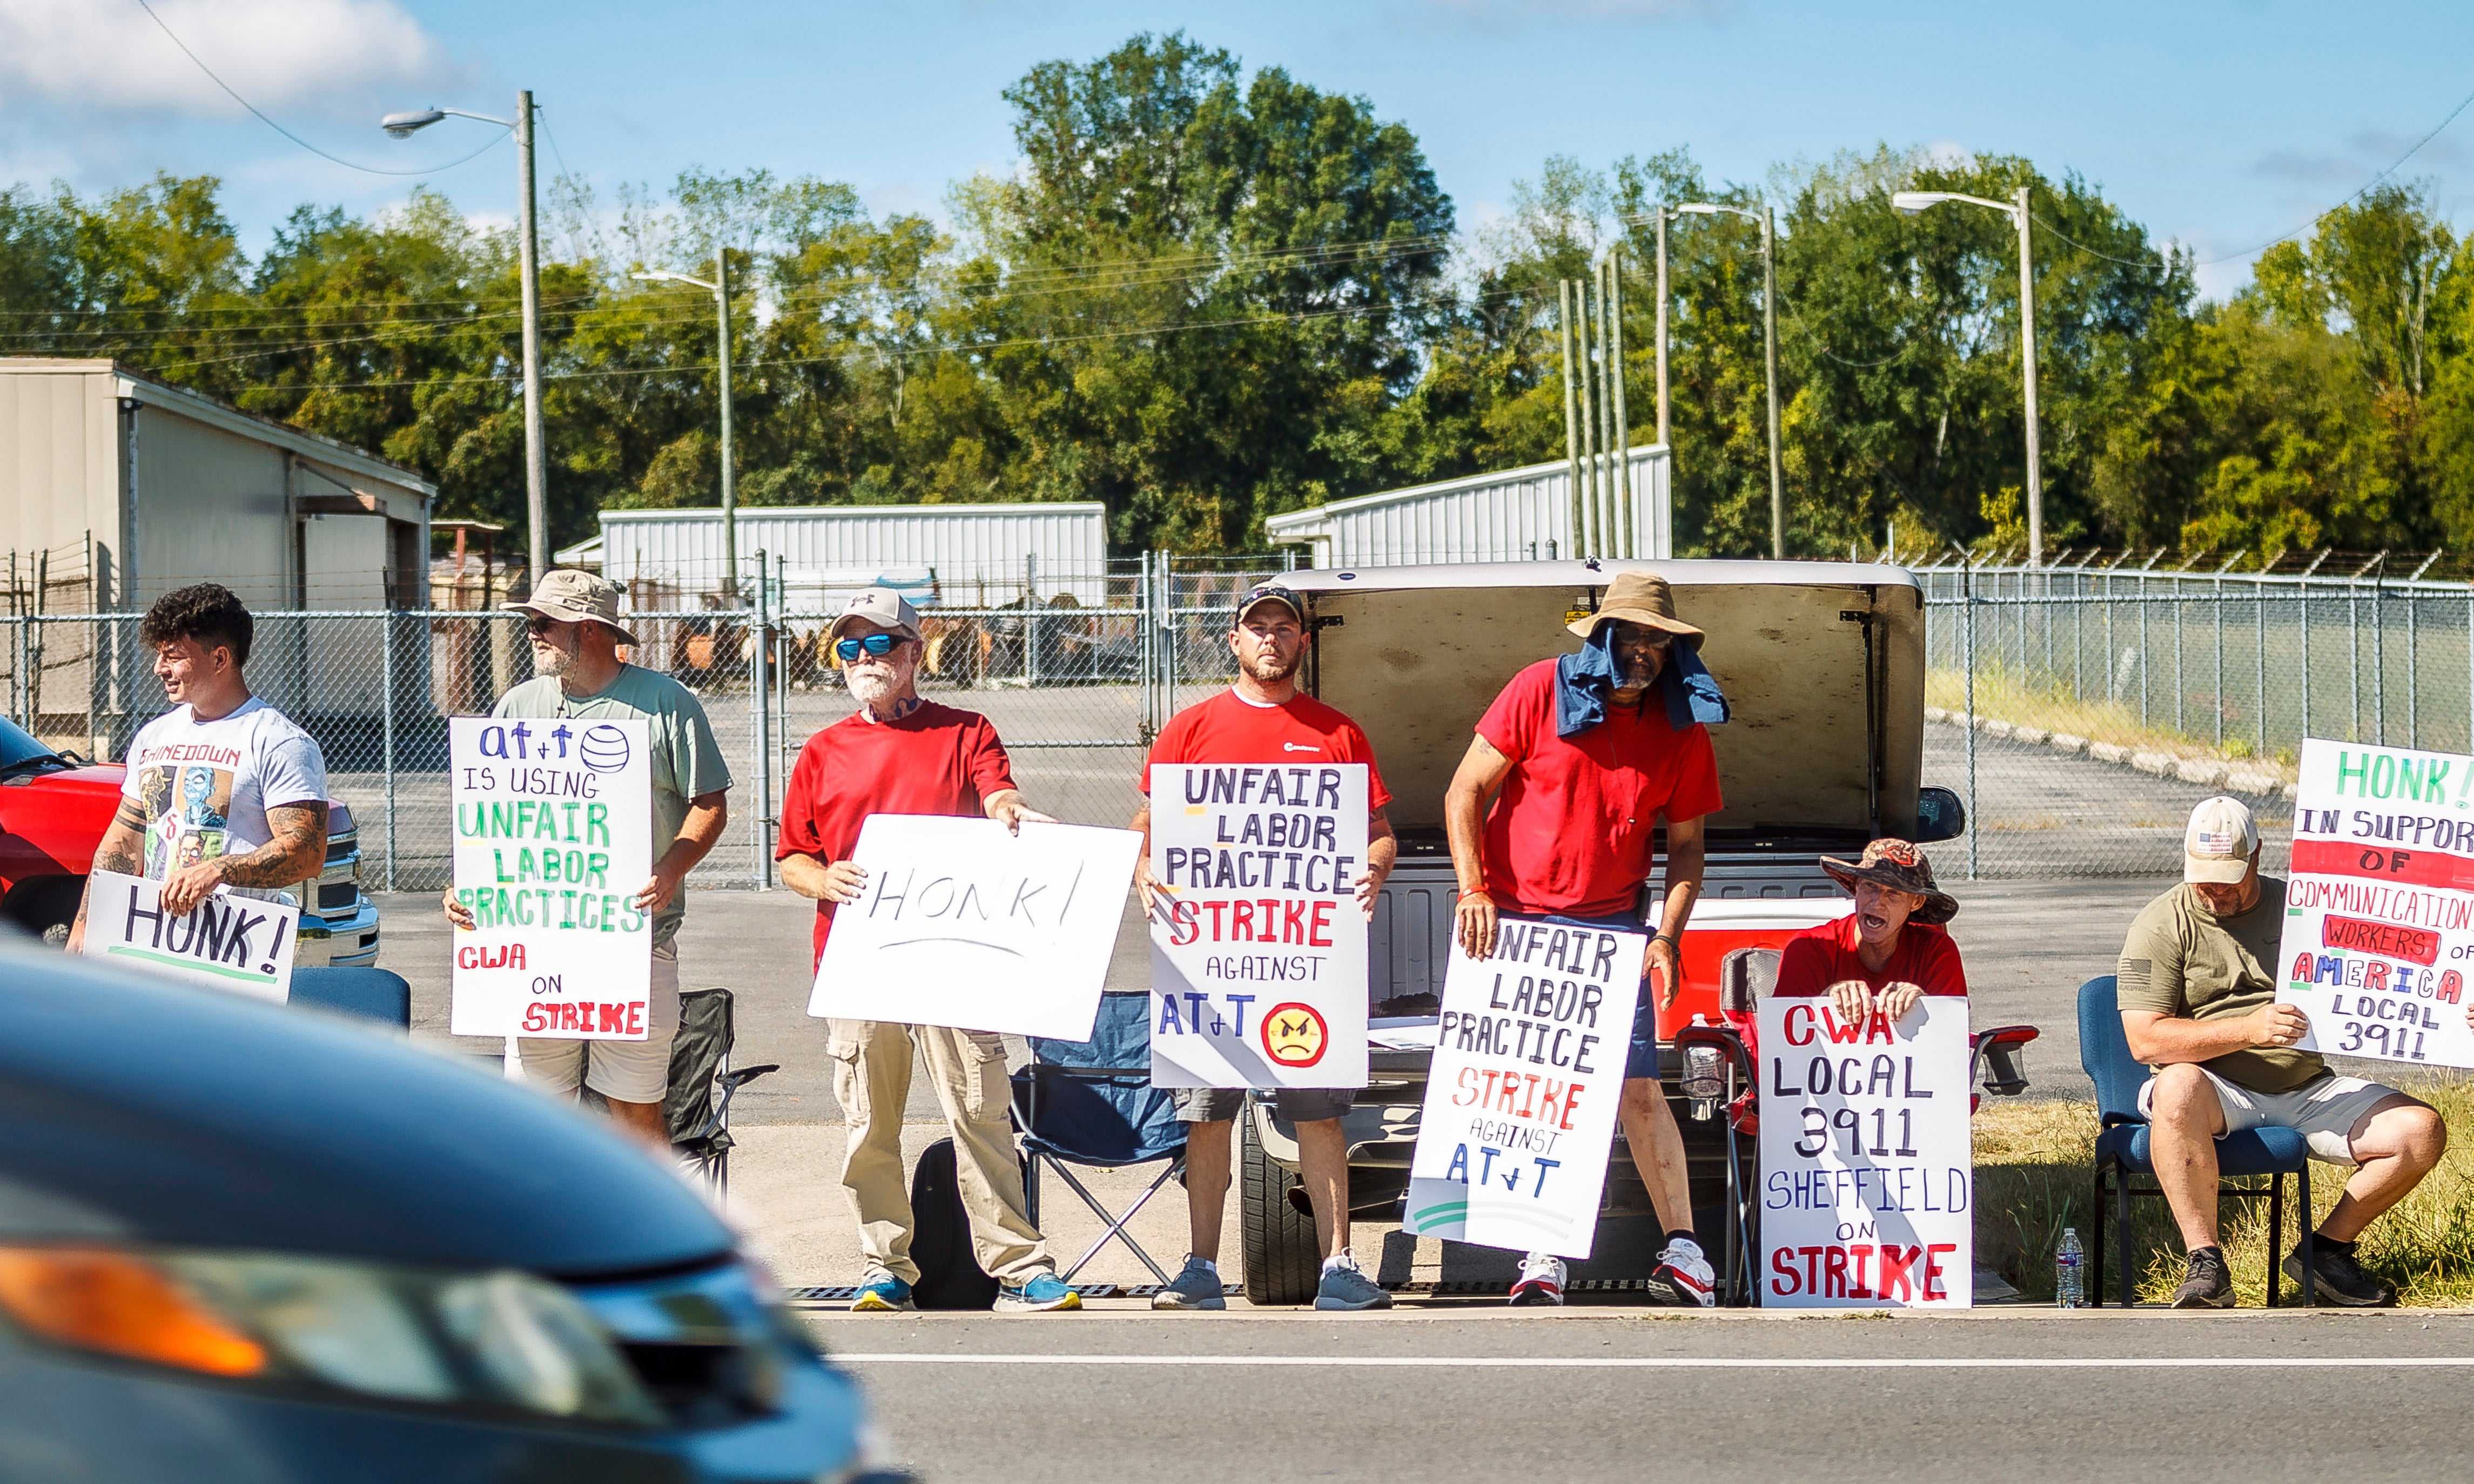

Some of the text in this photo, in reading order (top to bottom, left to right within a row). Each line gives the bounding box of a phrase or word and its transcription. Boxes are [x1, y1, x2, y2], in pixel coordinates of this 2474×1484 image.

[138, 744, 241, 767] SHINEDOWN
[463, 768, 600, 799] IS USING
[1185, 768, 1341, 810] UNFAIR
[2337, 751, 2474, 810] HONK!
[459, 800, 610, 848] UNFAIR
[1216, 813, 1336, 852] LABOR
[2298, 809, 2341, 833] IN
[494, 847, 608, 889] LABOR
[1166, 848, 1355, 894] PRACTICE
[2359, 849, 2410, 873] OF
[459, 887, 643, 933] PRACTICES
[869, 860, 1085, 946] HONK!
[1170, 900, 1337, 947] STRIKE
[2288, 879, 2474, 932] COMMUNICATION
[125, 885, 288, 975] HONK!
[2327, 919, 2426, 955] WORKERS
[458, 944, 526, 970] CWA
[1206, 956, 1327, 981] AGAINST
[1480, 923, 1617, 982] NFAIR
[532, 975, 562, 994] ON
[2291, 952, 2463, 1004] AMERICA
[522, 1001, 645, 1035] STRIKE
[1490, 974, 1602, 1027] LABOR
[2331, 995, 2439, 1030] LOCAL
[1438, 1011, 1599, 1074] PRACTICE
[1784, 1005, 1894, 1046] CWA
[2339, 1022, 2425, 1060] 3911
[1773, 1054, 1933, 1098] LOCAL
[1452, 1067, 1585, 1130] STRIKE
[1469, 1118, 1562, 1155] AGAINST
[1794, 1107, 1917, 1157] 3911
[1766, 1168, 1967, 1213] SHEFFIELD
[1836, 1220, 1875, 1241] ON
[1771, 1243, 1957, 1301] STRIKE
